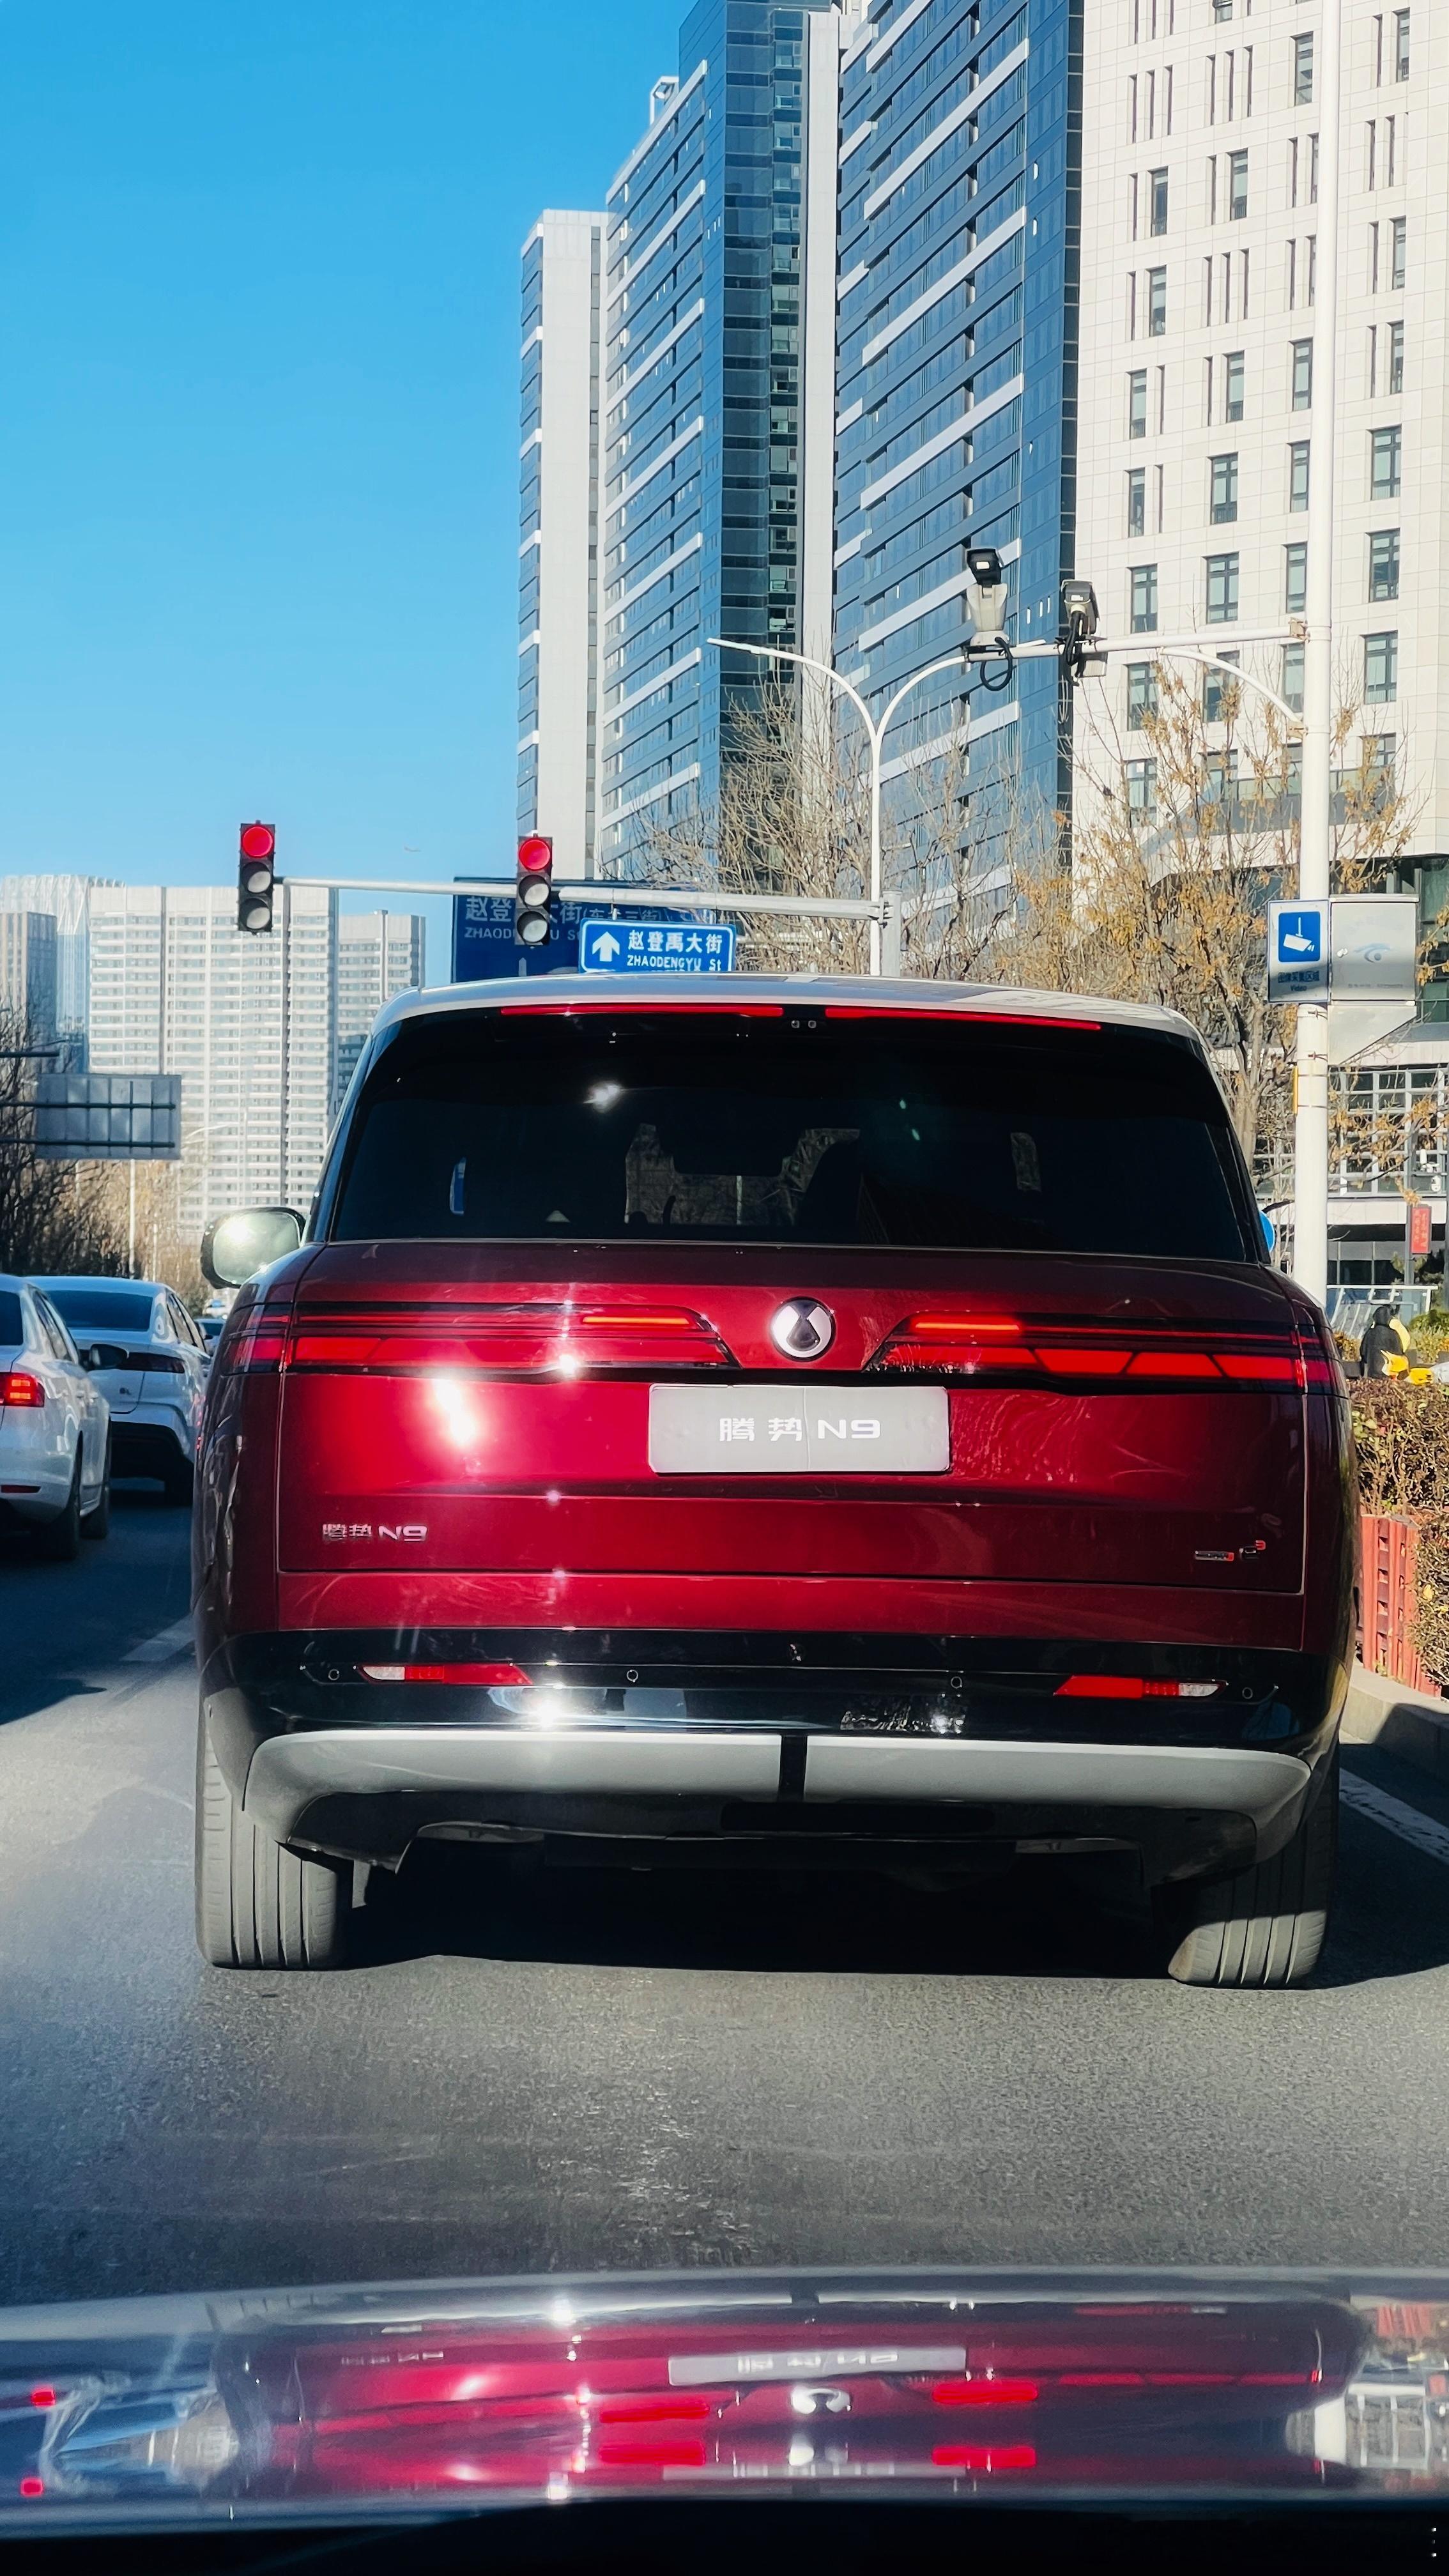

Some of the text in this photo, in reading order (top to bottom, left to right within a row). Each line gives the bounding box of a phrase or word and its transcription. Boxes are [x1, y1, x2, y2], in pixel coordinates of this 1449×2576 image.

[464, 927, 579, 940] ZHAODU S
[628, 930, 723, 954] 赵登禹大街
[627, 954, 722, 970] ZHAODENGYU St
[719, 1417, 881, 1442] 腾势 N9
[378, 1525, 428, 1542] N9
